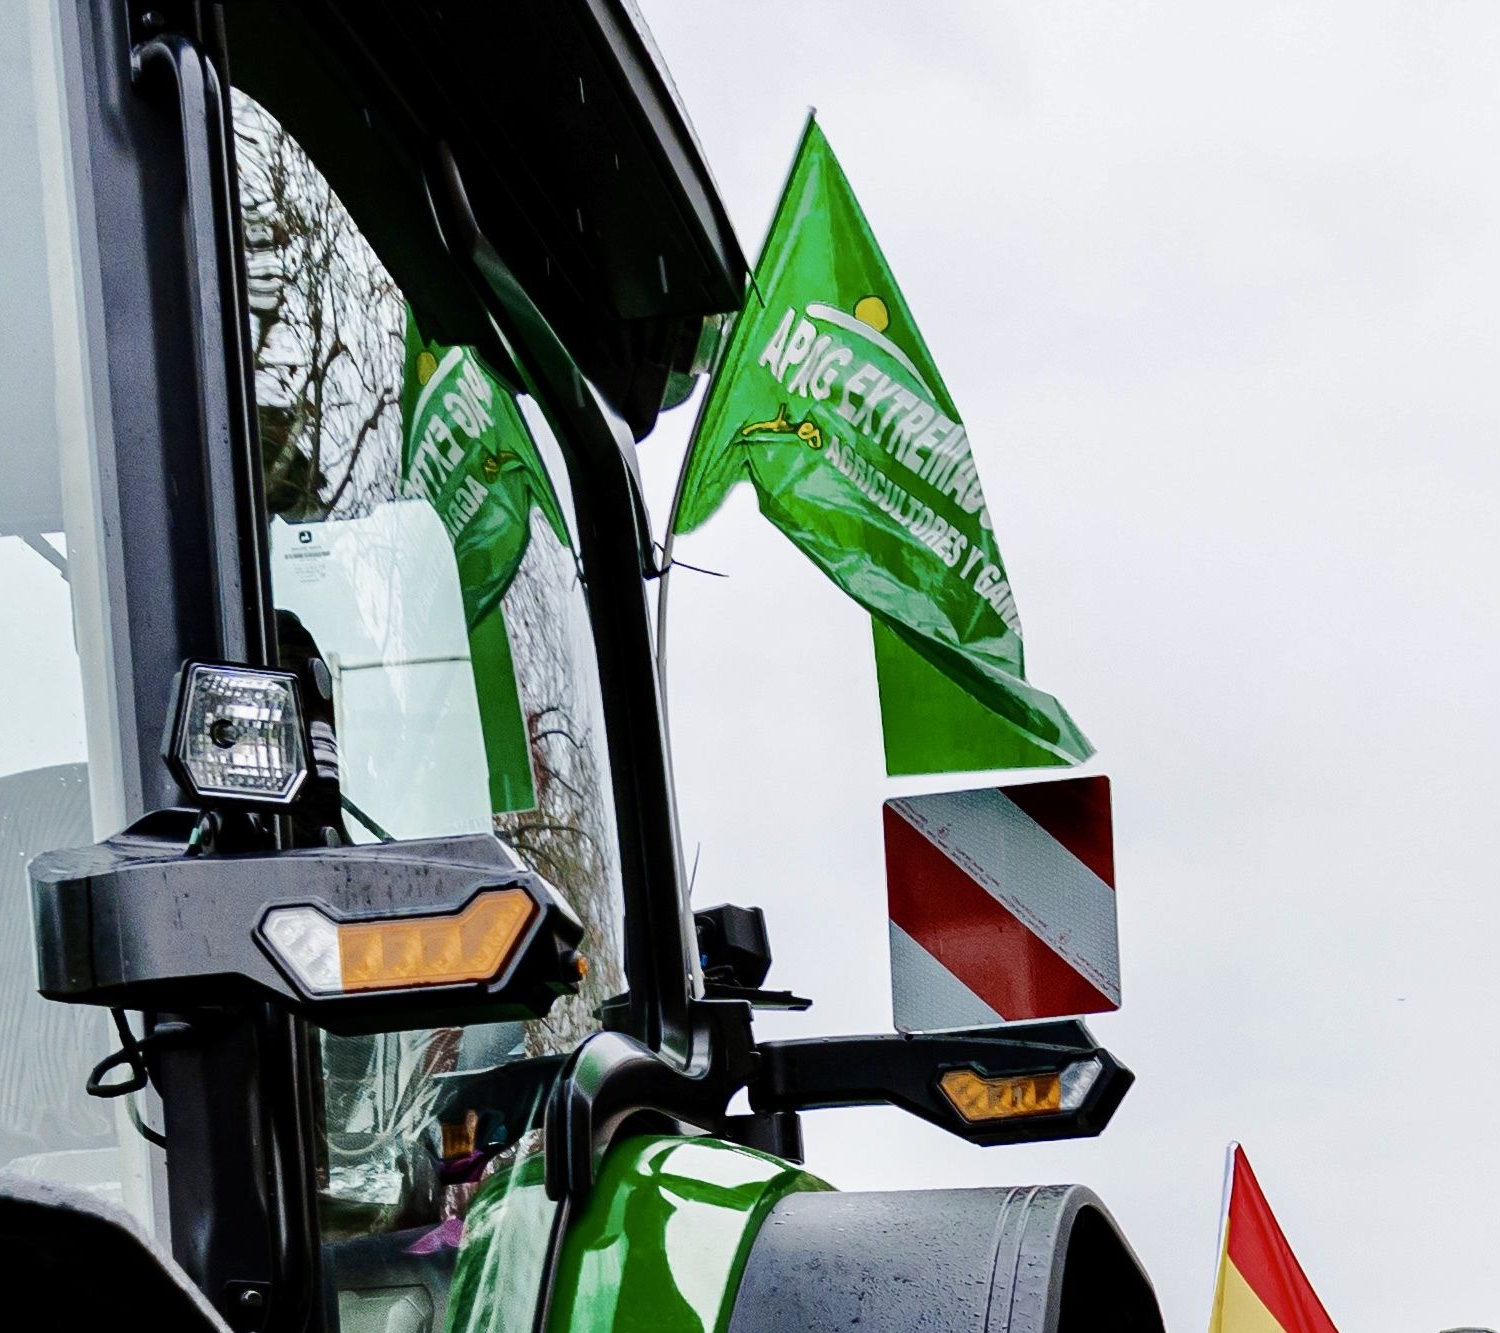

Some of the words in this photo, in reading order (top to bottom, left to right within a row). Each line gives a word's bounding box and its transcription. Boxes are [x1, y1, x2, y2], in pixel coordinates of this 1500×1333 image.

[759, 306, 853, 401] APAG
[824, 434, 968, 568] AGRICULTORES
[959, 545, 985, 580] Y
